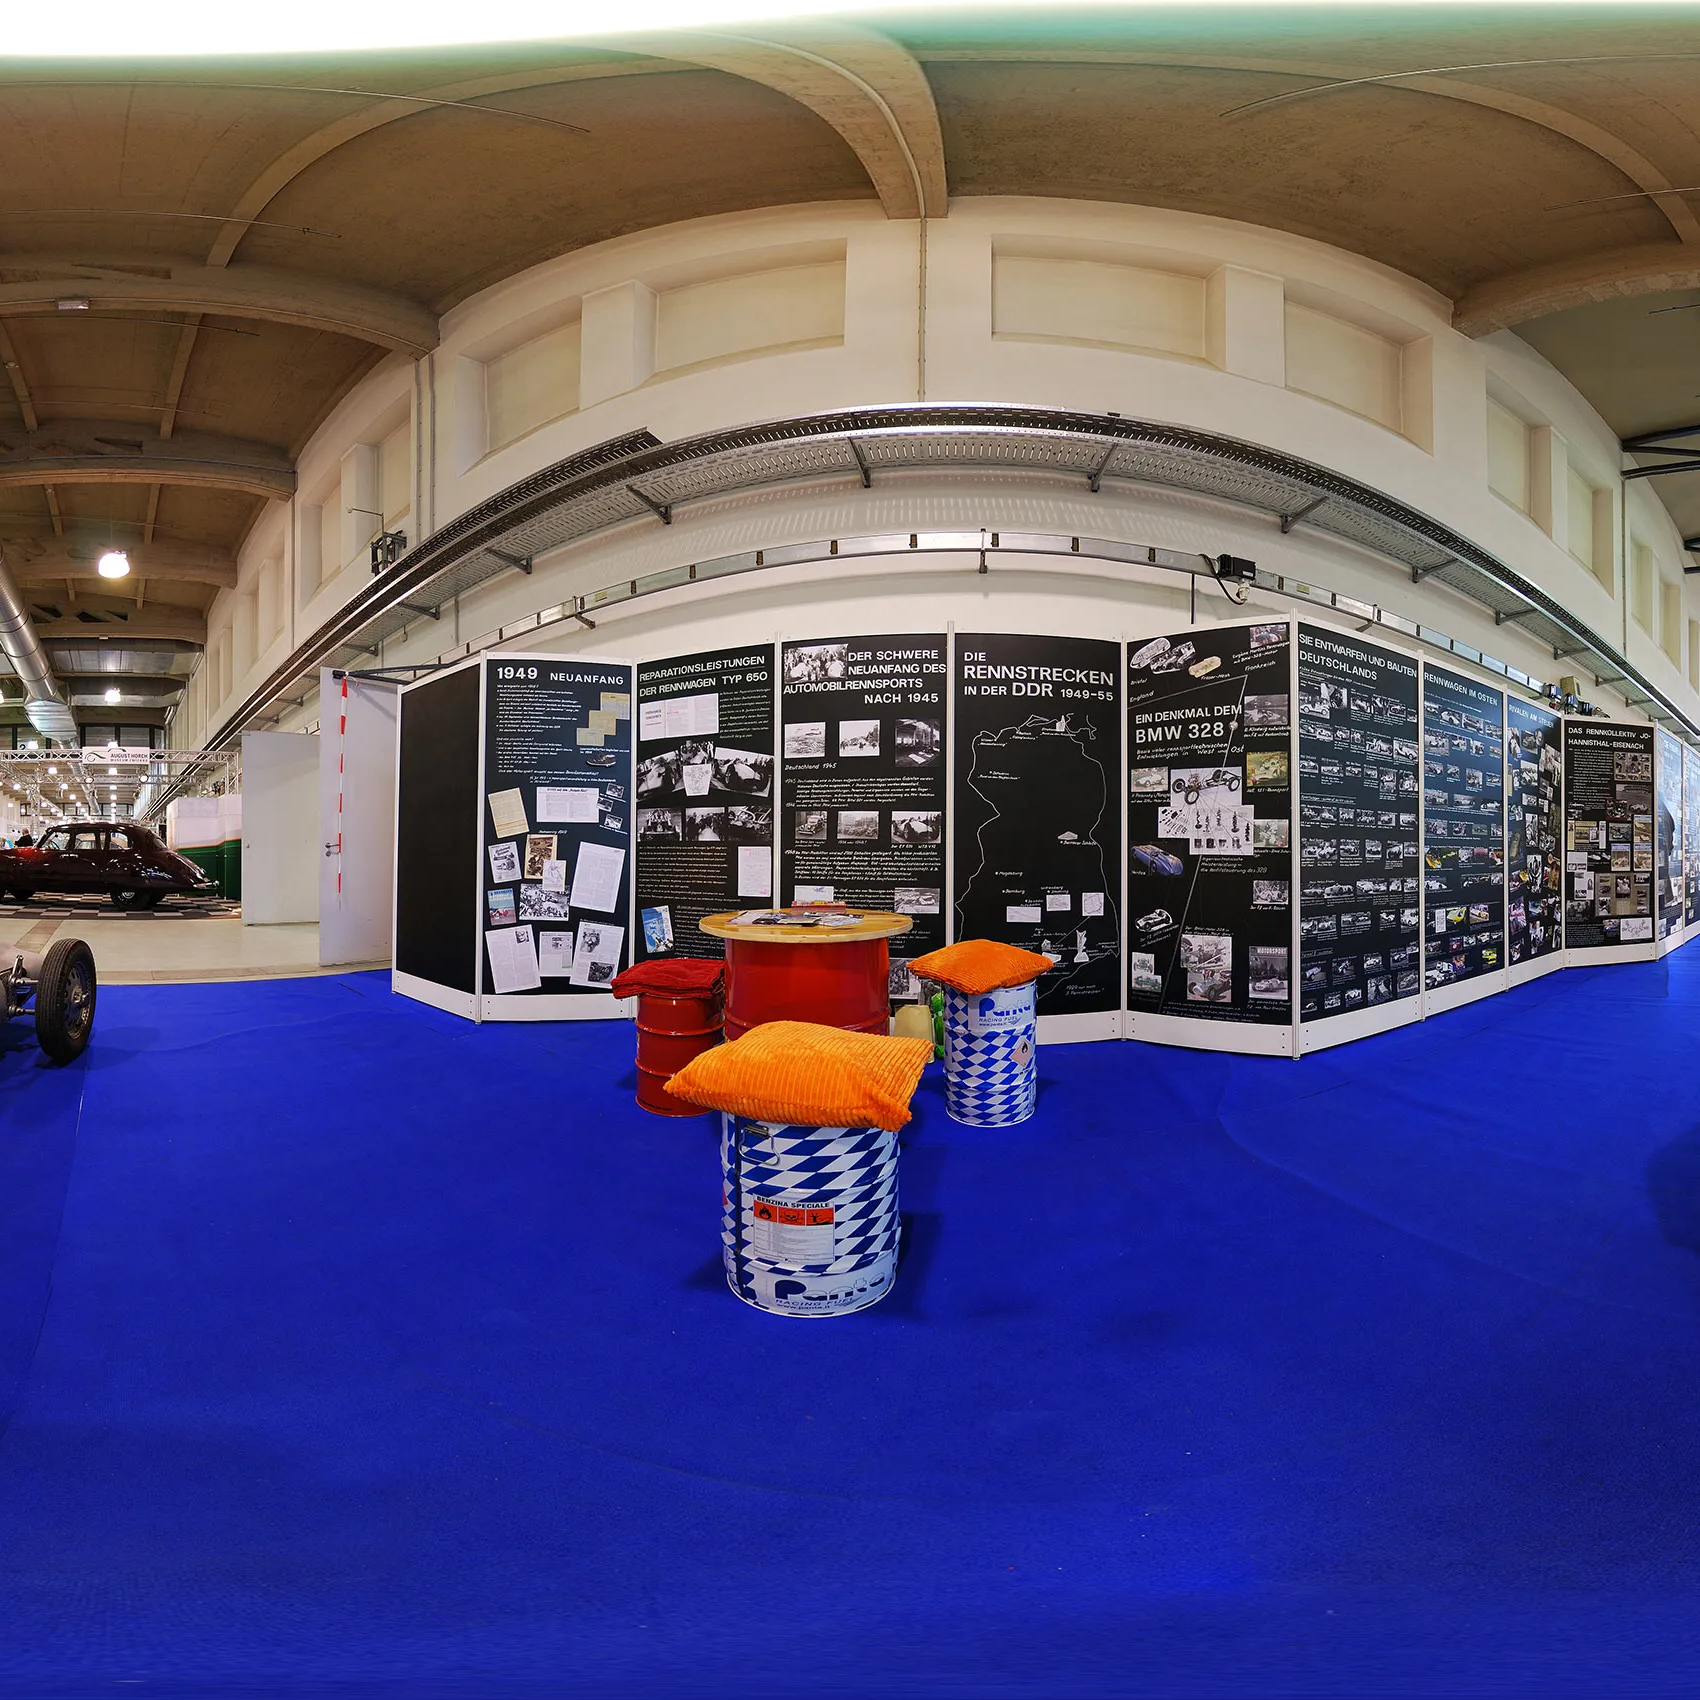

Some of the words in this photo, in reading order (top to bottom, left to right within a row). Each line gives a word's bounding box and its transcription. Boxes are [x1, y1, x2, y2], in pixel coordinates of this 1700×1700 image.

[849, 651, 872, 661] DER
[876, 650, 939, 660] SCHWERE
[964, 652, 986, 661] DIE
[1299, 633, 1313, 646] SIE
[1315, 638, 1368, 661] ENTWARFEN
[1368, 655, 1385, 668] UND
[1387, 661, 1417, 678] BAUTEN
[640, 656, 765, 681] REPARATIONSLEISTUNGEN
[849, 664, 920, 675] NEUANFANG
[923, 664, 946, 673] DES
[1245, 660, 1276, 671] Frankreich
[1300, 650, 1377, 680] DEUTSCHLANDS
[497, 667, 538, 679] 1949
[550, 673, 624, 685] NEUANFANG
[640, 686, 657, 697] DER
[659, 678, 716, 693] RENNWAGEN
[722, 675, 742, 684] TYP
[746, 671, 768, 682] 650
[964, 665, 1113, 686] RENNSTRECKEN
[783, 679, 923, 694] AUTOMOBILRENNSPORTS
[964, 686, 977, 695] IN
[981, 686, 1007, 695] DER
[1012, 682, 1053, 697] DDR
[1061, 689, 1114, 701] 1949-55
[1424, 672, 1467, 696] RENNWAGEN
[1468, 689, 1477, 697] IM
[1478, 692, 1498, 706] OSTEN
[864, 693, 901, 704] NACH
[908, 693, 939, 703] 1945
[1129, 691, 1154, 703] England
[1135, 714, 1153, 724] EIN
[1155, 707, 1211, 722] DENKMAL
[1214, 705, 1242, 716] DEM
[1509, 704, 1529, 719] RIVALEN
[1530, 713, 1538, 722] AM
[1135, 725, 1182, 744] BMW
[1188, 722, 1224, 738] 328
[1585, 728, 1637, 738] RENNKOLLEKTIV
[1640, 732, 1651, 740] JO-
[1137, 752, 1179, 760] Entwicklungen
[1231, 745, 1244, 753] Ost
[1568, 739, 1644, 750] HANNISTHAL-EISENACH
[785, 763, 819, 771] Deutschland
[979, 997, 1031, 1017] Panta
[756, 1196, 788, 1207] BENZINA
[774, 1272, 885, 1301] Panta
